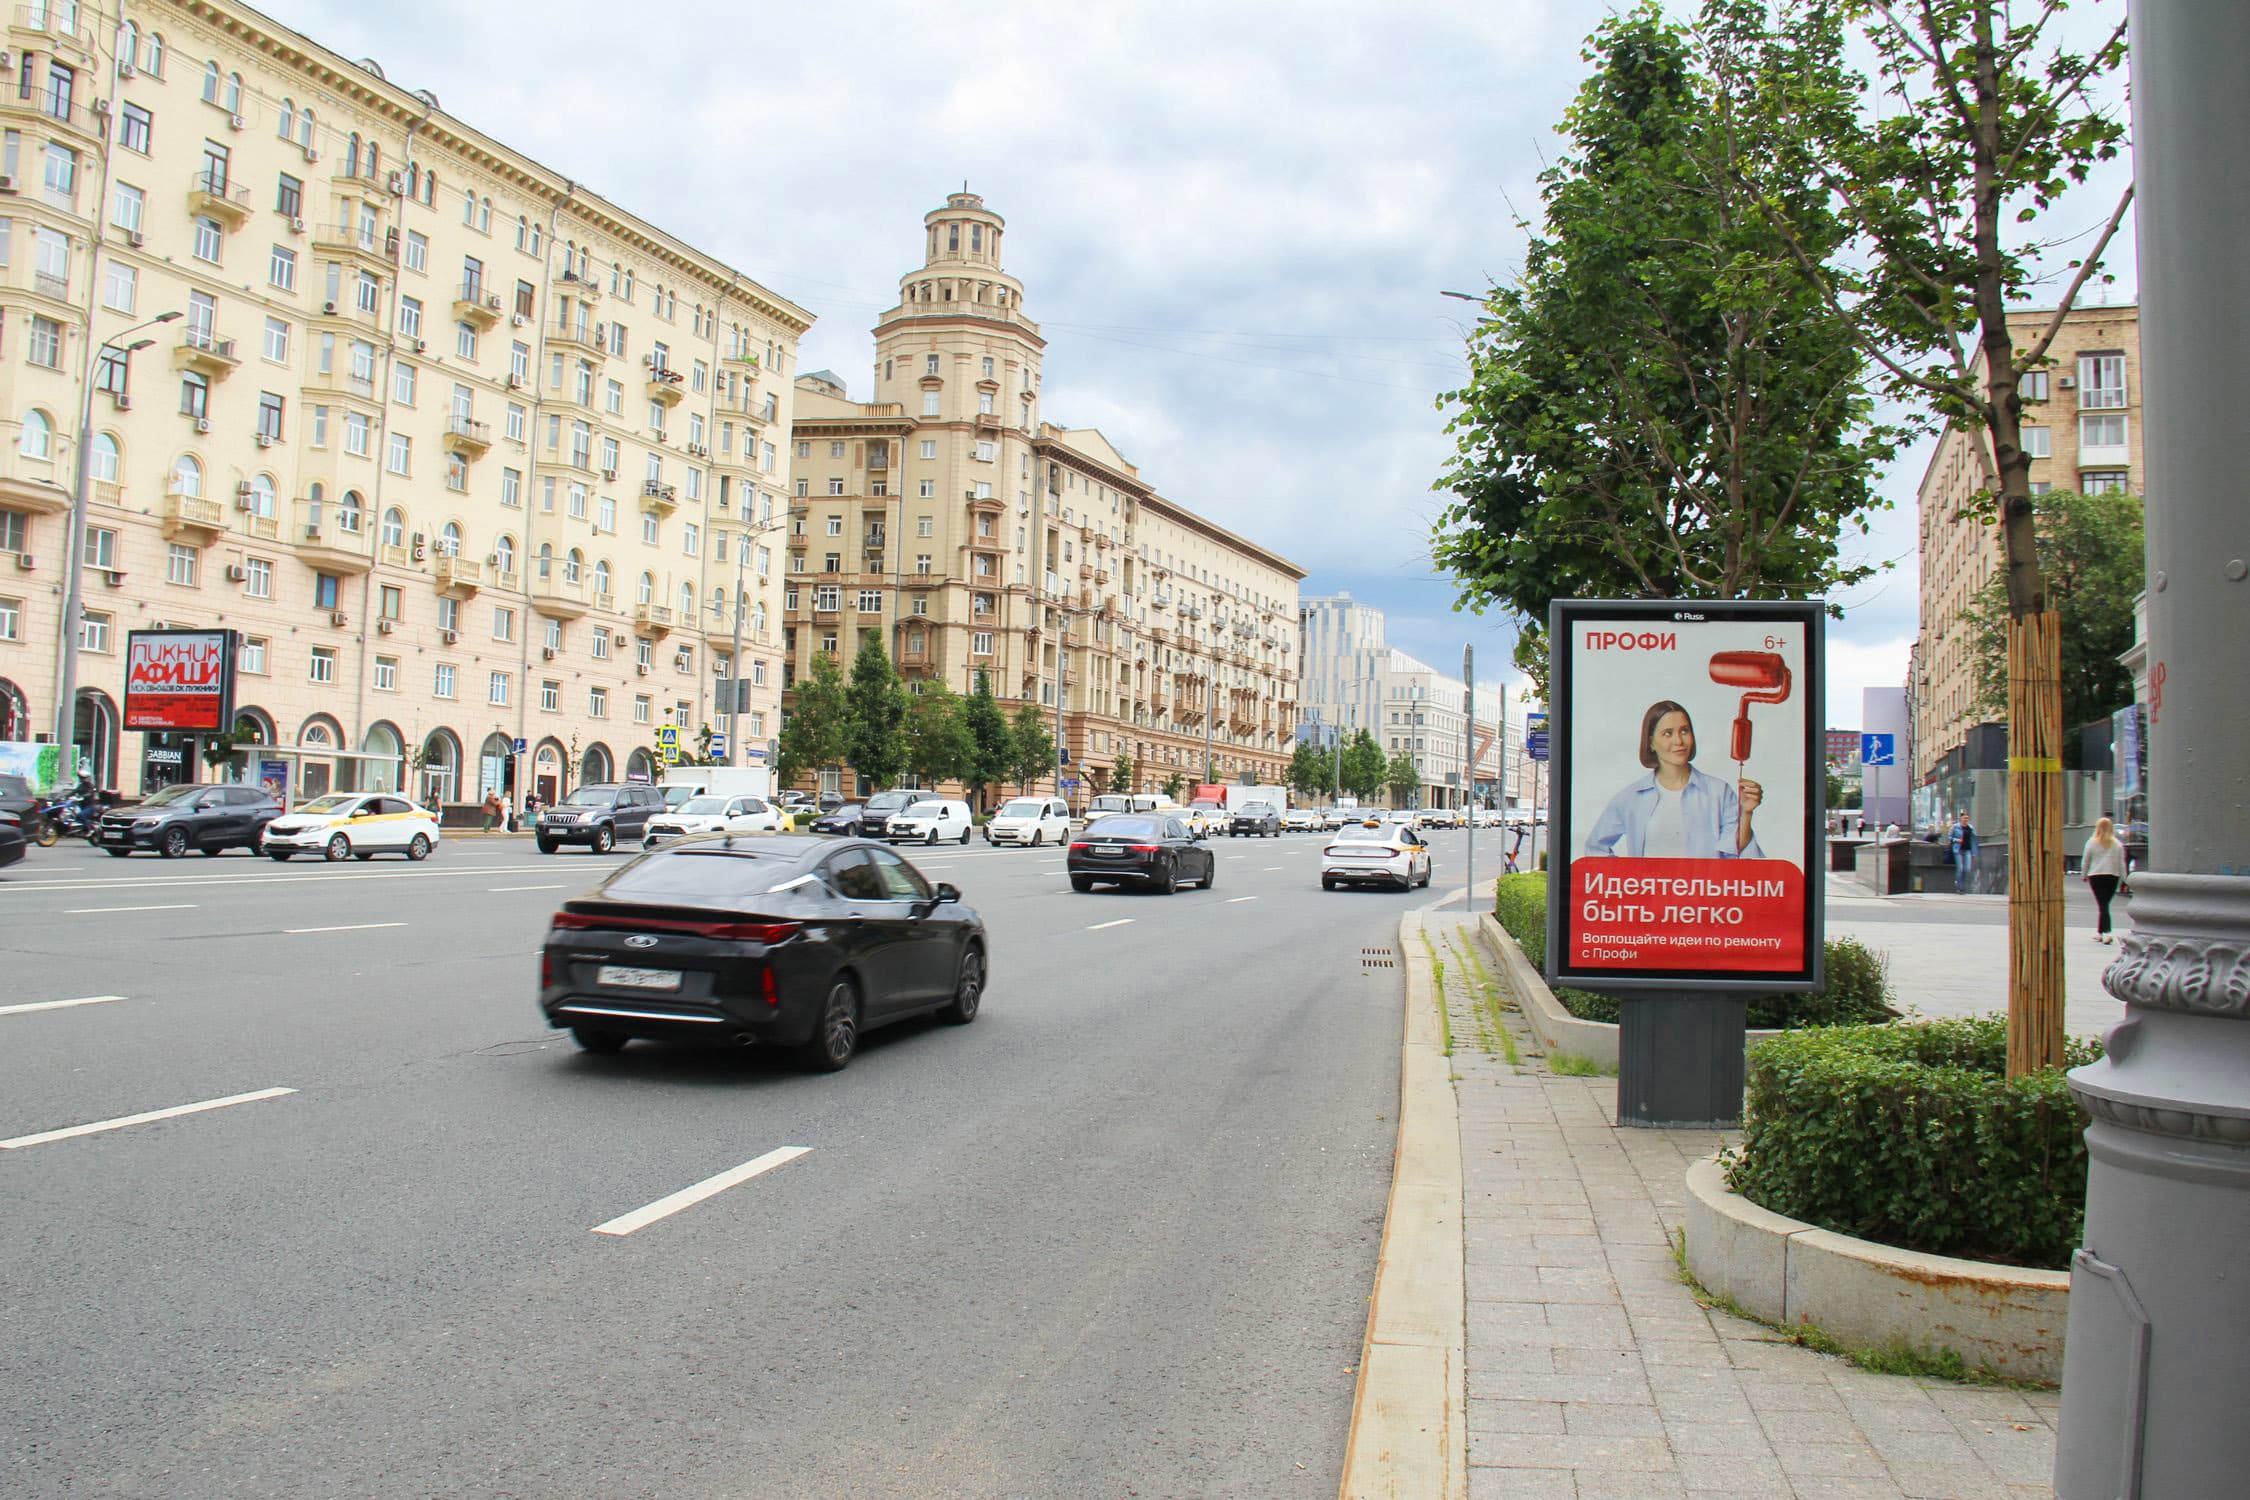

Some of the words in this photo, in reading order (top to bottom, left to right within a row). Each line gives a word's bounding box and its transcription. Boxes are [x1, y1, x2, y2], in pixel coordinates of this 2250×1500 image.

[1586, 632, 1676, 651] ПРОФИ
[1764, 635, 1787, 650] 6+
[133, 643, 221, 662] ПИКНИК
[131, 662, 220, 685] АФИШИ
[1584, 872, 1784, 899] Идеятельным
[1583, 900, 1656, 923] быть
[1661, 905, 1744, 924] легко
[1582, 932, 1667, 946] Воплощайте
[1670, 936, 1702, 947] идеи
[1705, 937, 1721, 946] по
[1724, 937, 1781, 949] ремонту
[1582, 950, 1590, 959] с
[1593, 948, 1638, 961] Профи
